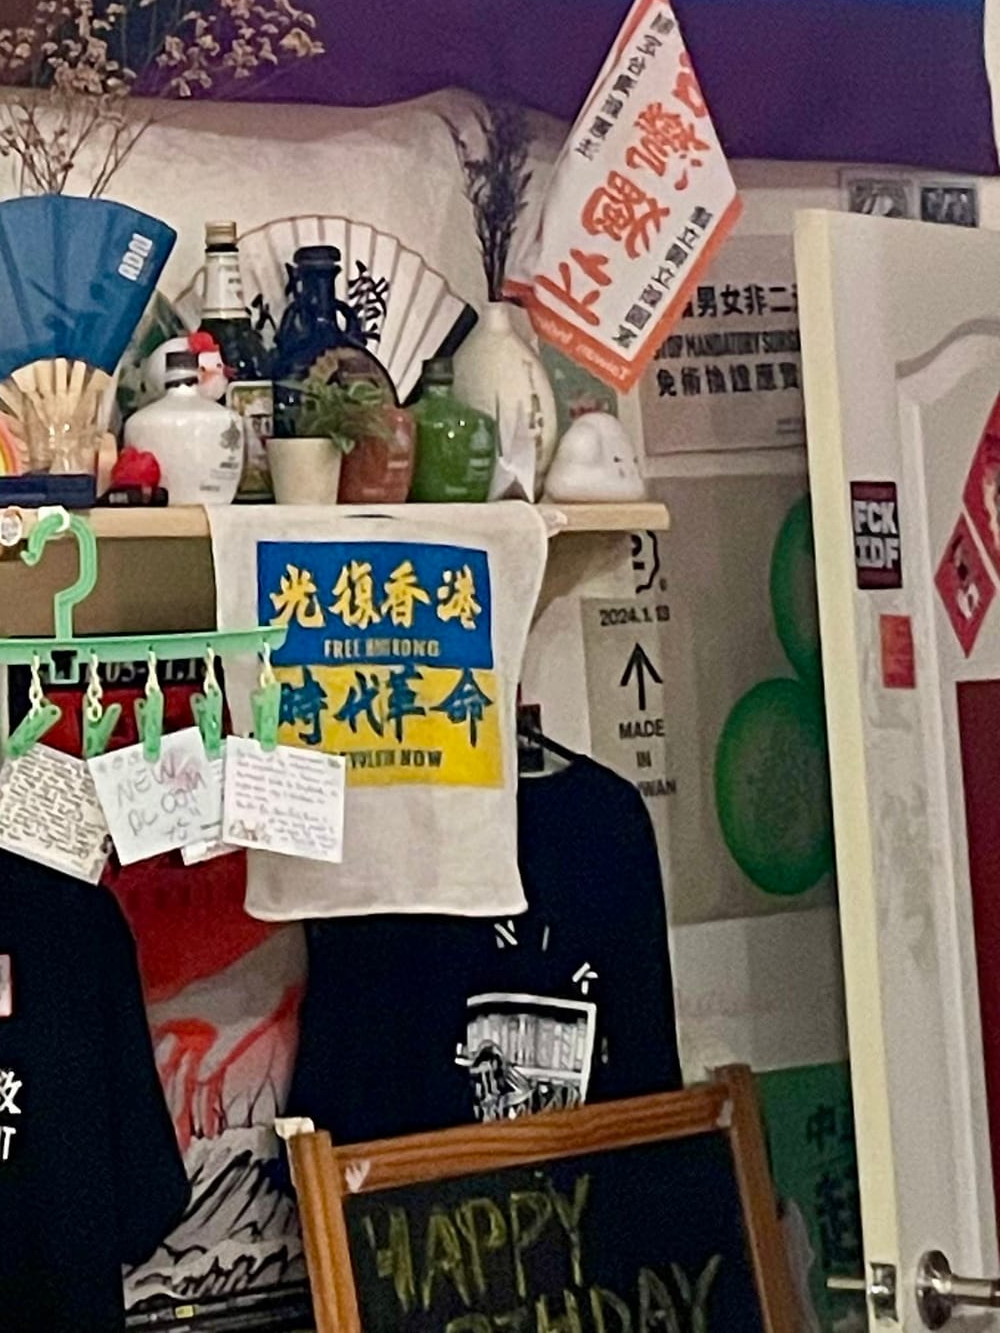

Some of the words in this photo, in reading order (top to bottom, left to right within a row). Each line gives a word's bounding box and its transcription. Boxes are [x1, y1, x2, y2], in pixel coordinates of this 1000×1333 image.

[853, 501, 897, 534] FCK
[855, 536, 899, 569] IDF
[269, 560, 482, 630] 光復香港
[619, 719, 665, 739] MADE
[400, 750, 442, 767] NOW
[363, 1172, 590, 1313] HAPPY
